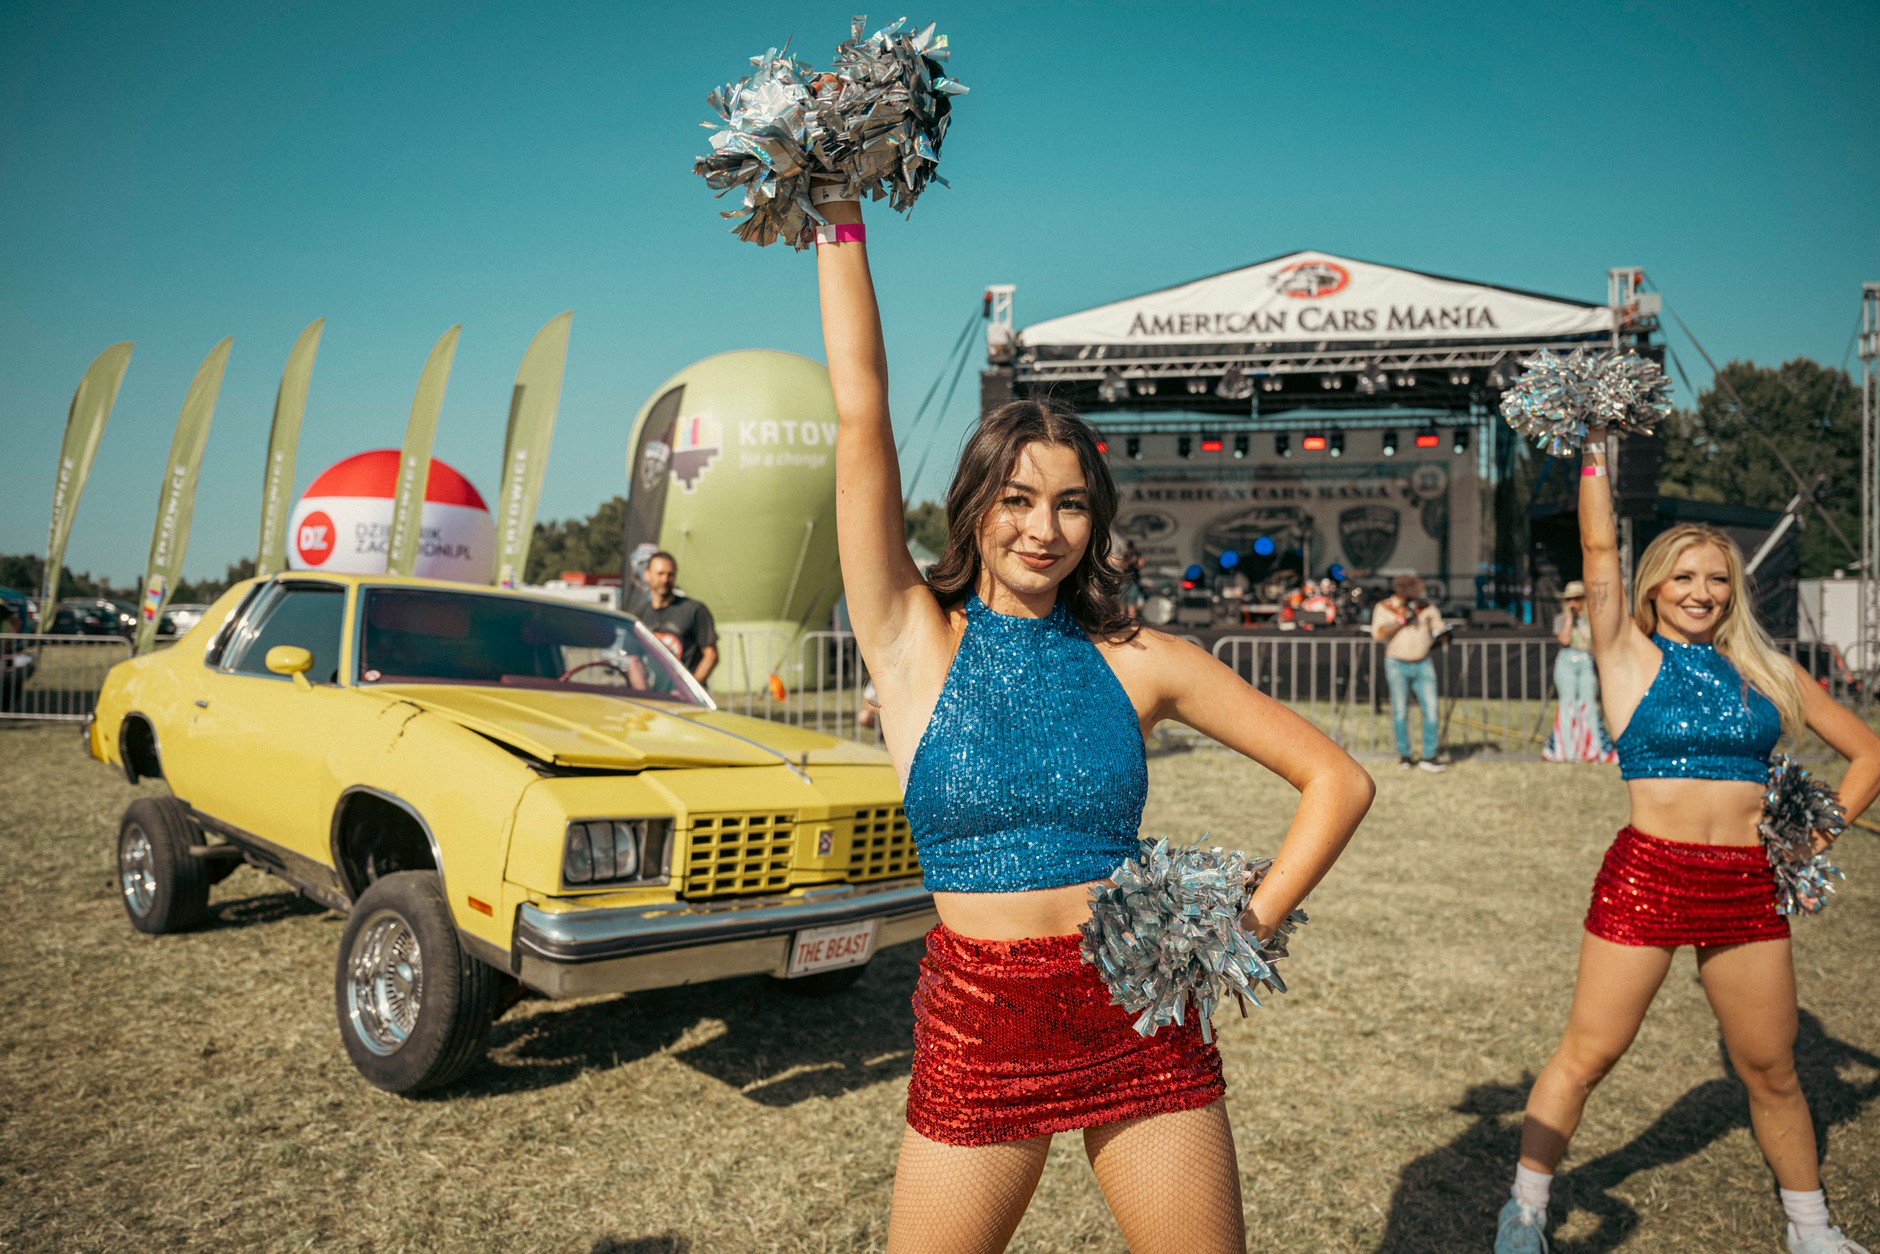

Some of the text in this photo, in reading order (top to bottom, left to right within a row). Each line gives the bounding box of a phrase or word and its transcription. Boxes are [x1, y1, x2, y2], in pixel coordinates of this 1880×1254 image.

[1128, 304, 1498, 336] AMERICAN CARS MANIA
[301, 526, 328, 550] DZ
[797, 939, 825, 966] THE
[825, 931, 870, 960] BEAST
